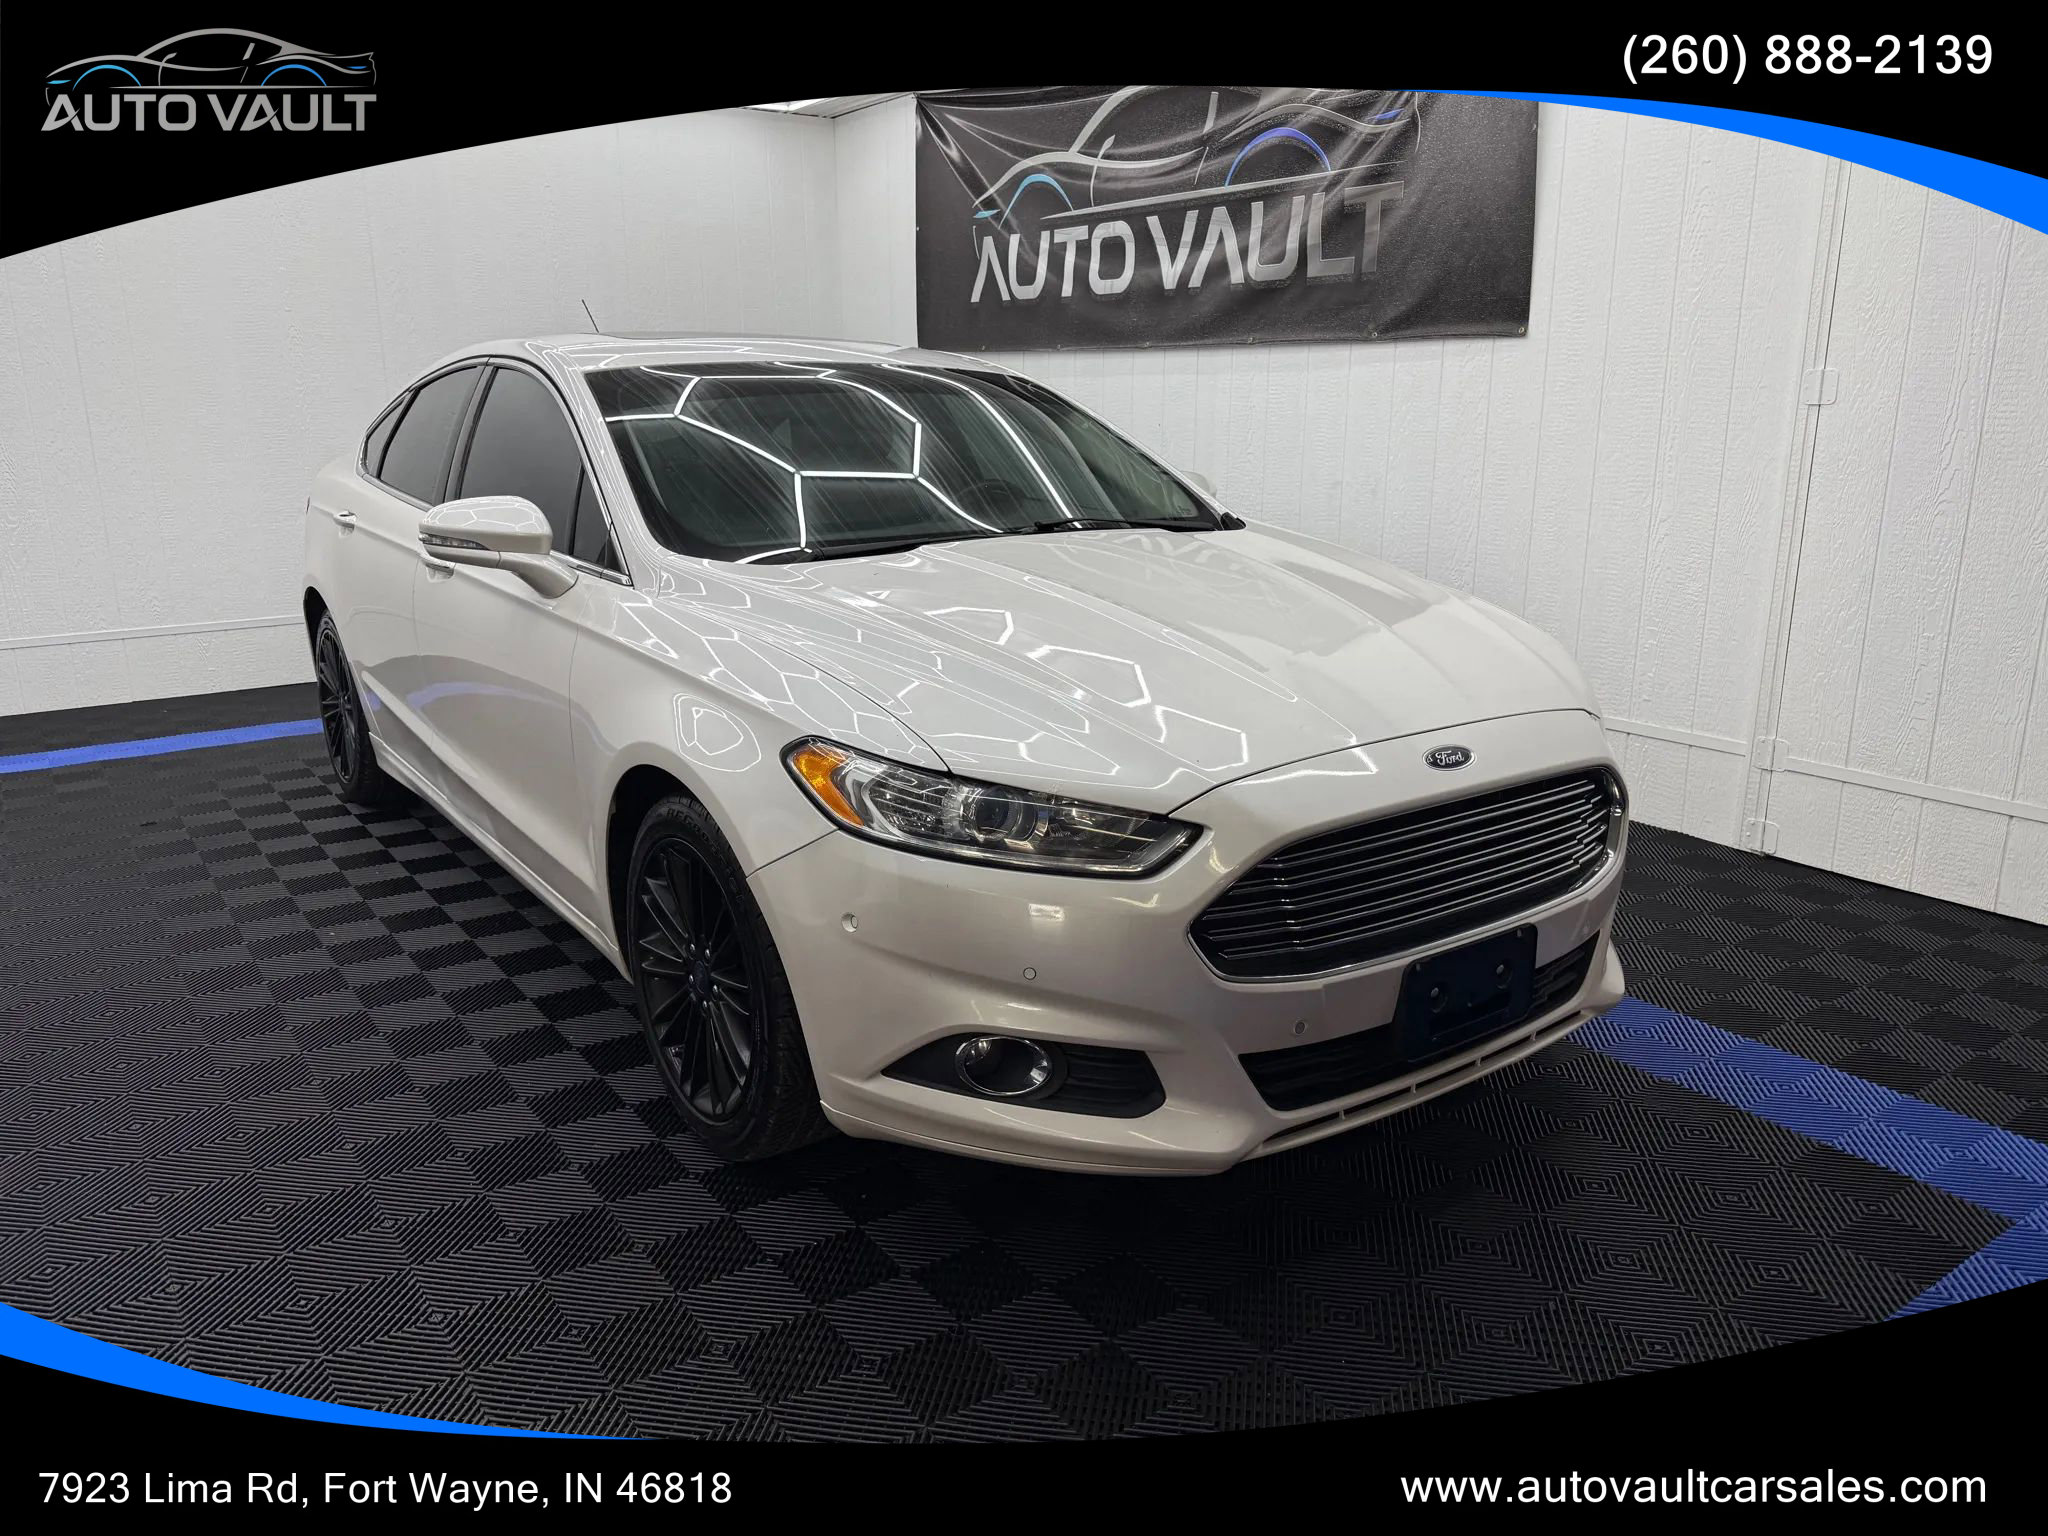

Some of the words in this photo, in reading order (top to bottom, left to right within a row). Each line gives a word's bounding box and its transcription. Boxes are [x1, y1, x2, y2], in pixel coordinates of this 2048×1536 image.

[970, 220, 1136, 303] AUTO
[1145, 181, 1405, 290] VAULT
[1435, 750, 1465, 766] Ford
